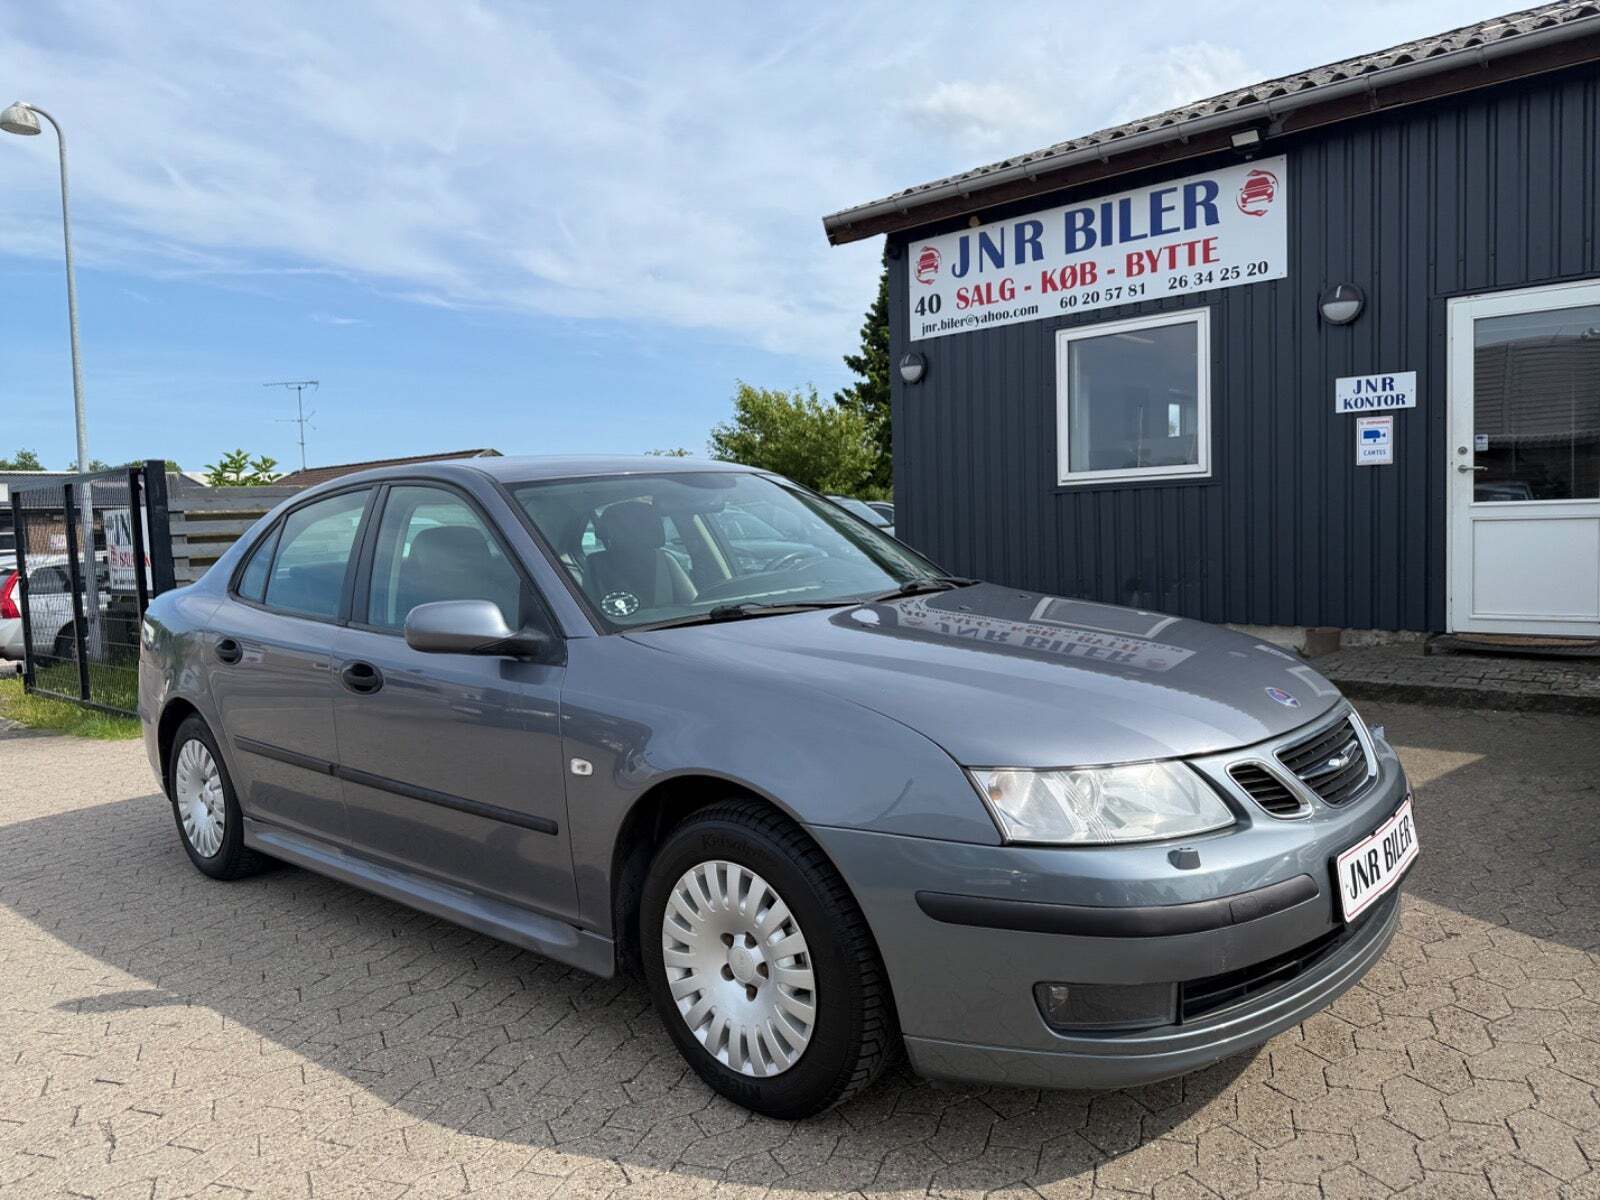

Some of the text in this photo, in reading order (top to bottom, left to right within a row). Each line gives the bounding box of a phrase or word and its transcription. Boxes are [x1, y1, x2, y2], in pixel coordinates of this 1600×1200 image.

[951, 179, 1220, 278] JNR BILER
[914, 293, 942, 317] 40
[921, 261, 1269, 336] jnr.biler@yahoo.com 60 20 57 81 26 34 25 20
[956, 278, 1016, 310] SALG
[1041, 261, 1098, 294] KØB
[1126, 236, 1220, 278] BYTTE
[1343, 393, 1406, 410] KONTOR
[1353, 376, 1395, 394] JNR
[1349, 814, 1412, 900] JNR BILER
